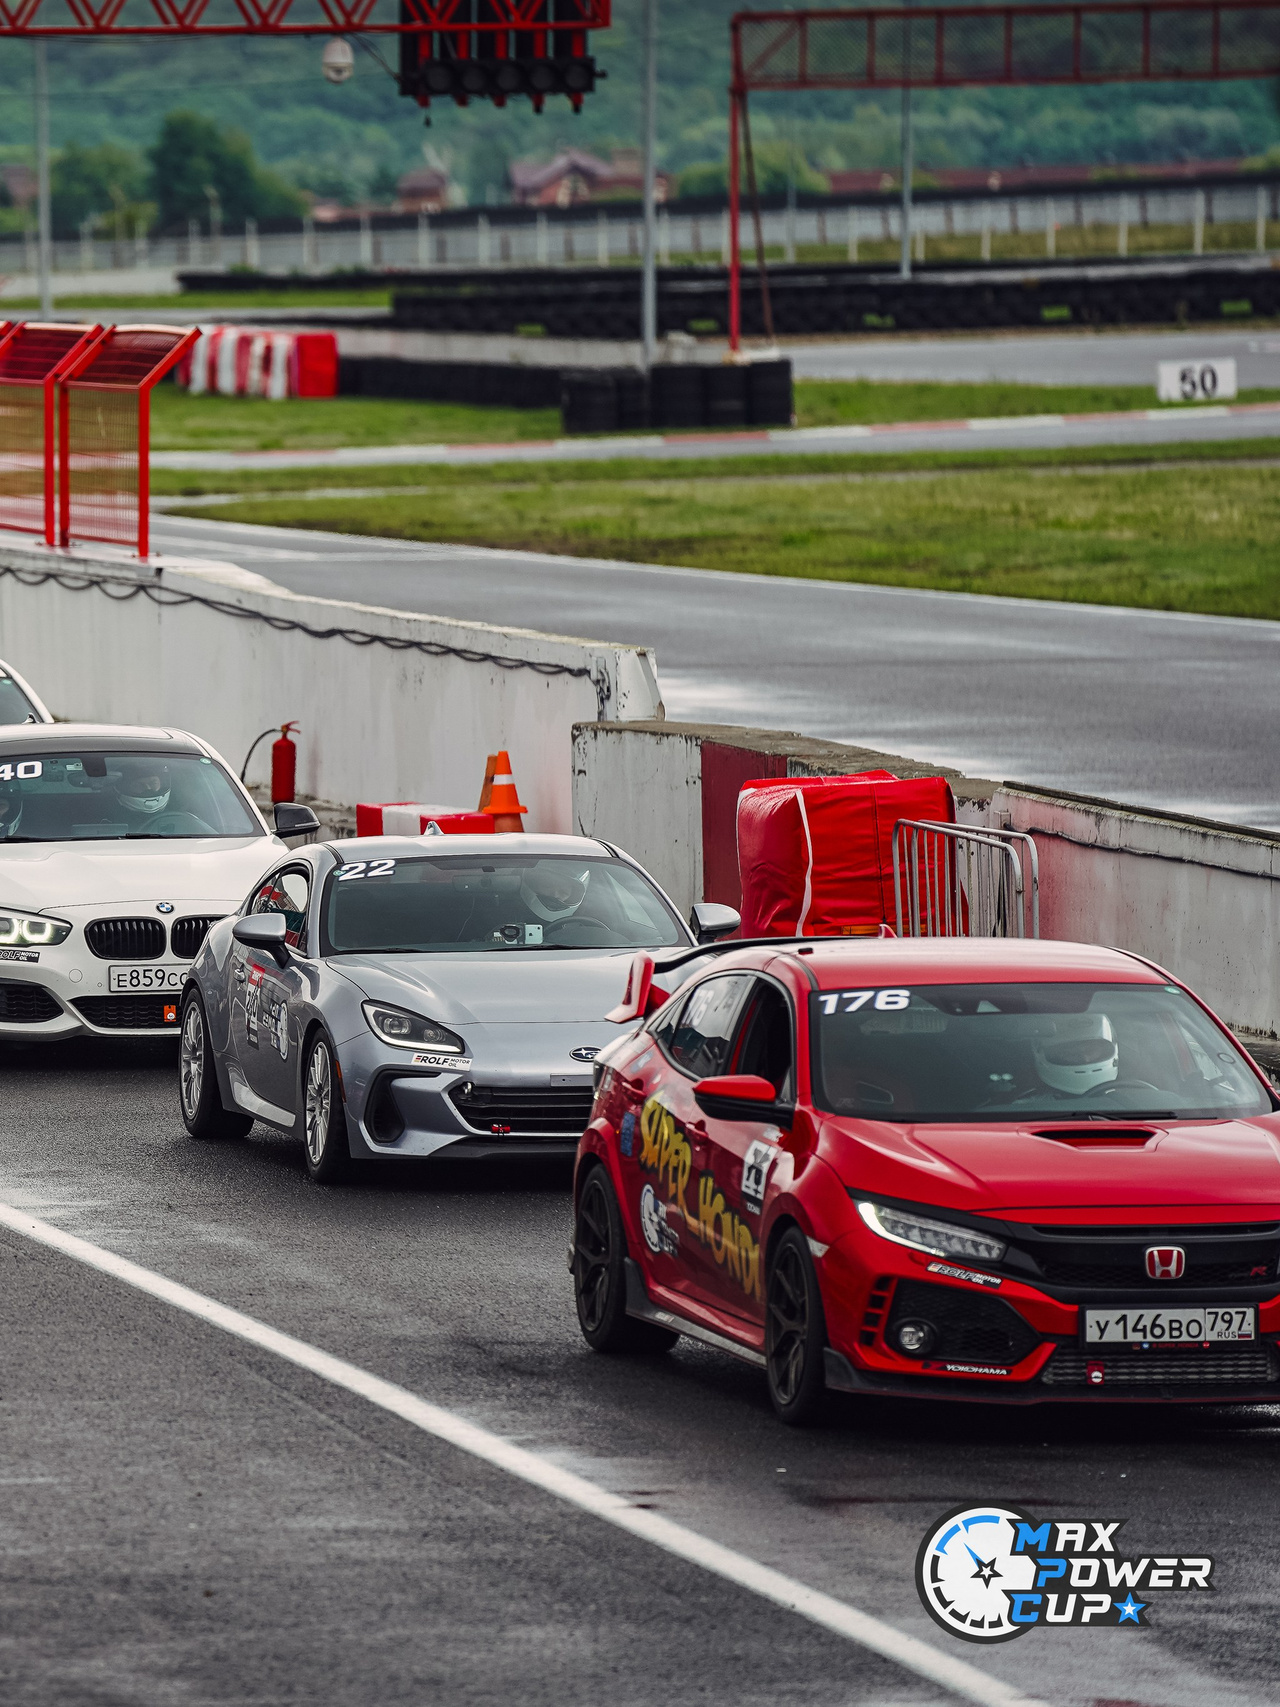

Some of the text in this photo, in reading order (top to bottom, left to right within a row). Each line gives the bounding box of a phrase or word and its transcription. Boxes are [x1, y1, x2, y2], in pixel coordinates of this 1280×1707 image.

[1179, 366, 1218, 400] 50
[338, 860, 396, 881] 22
[819, 989, 911, 1015] 176
[421, 1055, 450, 1067] ROLF
[939, 1263, 1001, 1284] ROLF MOTOR
[1207, 1311, 1248, 1331] 797
[1217, 1331, 1237, 1339] RUS
[945, 1364, 1008, 1375] YOKOHAMA
